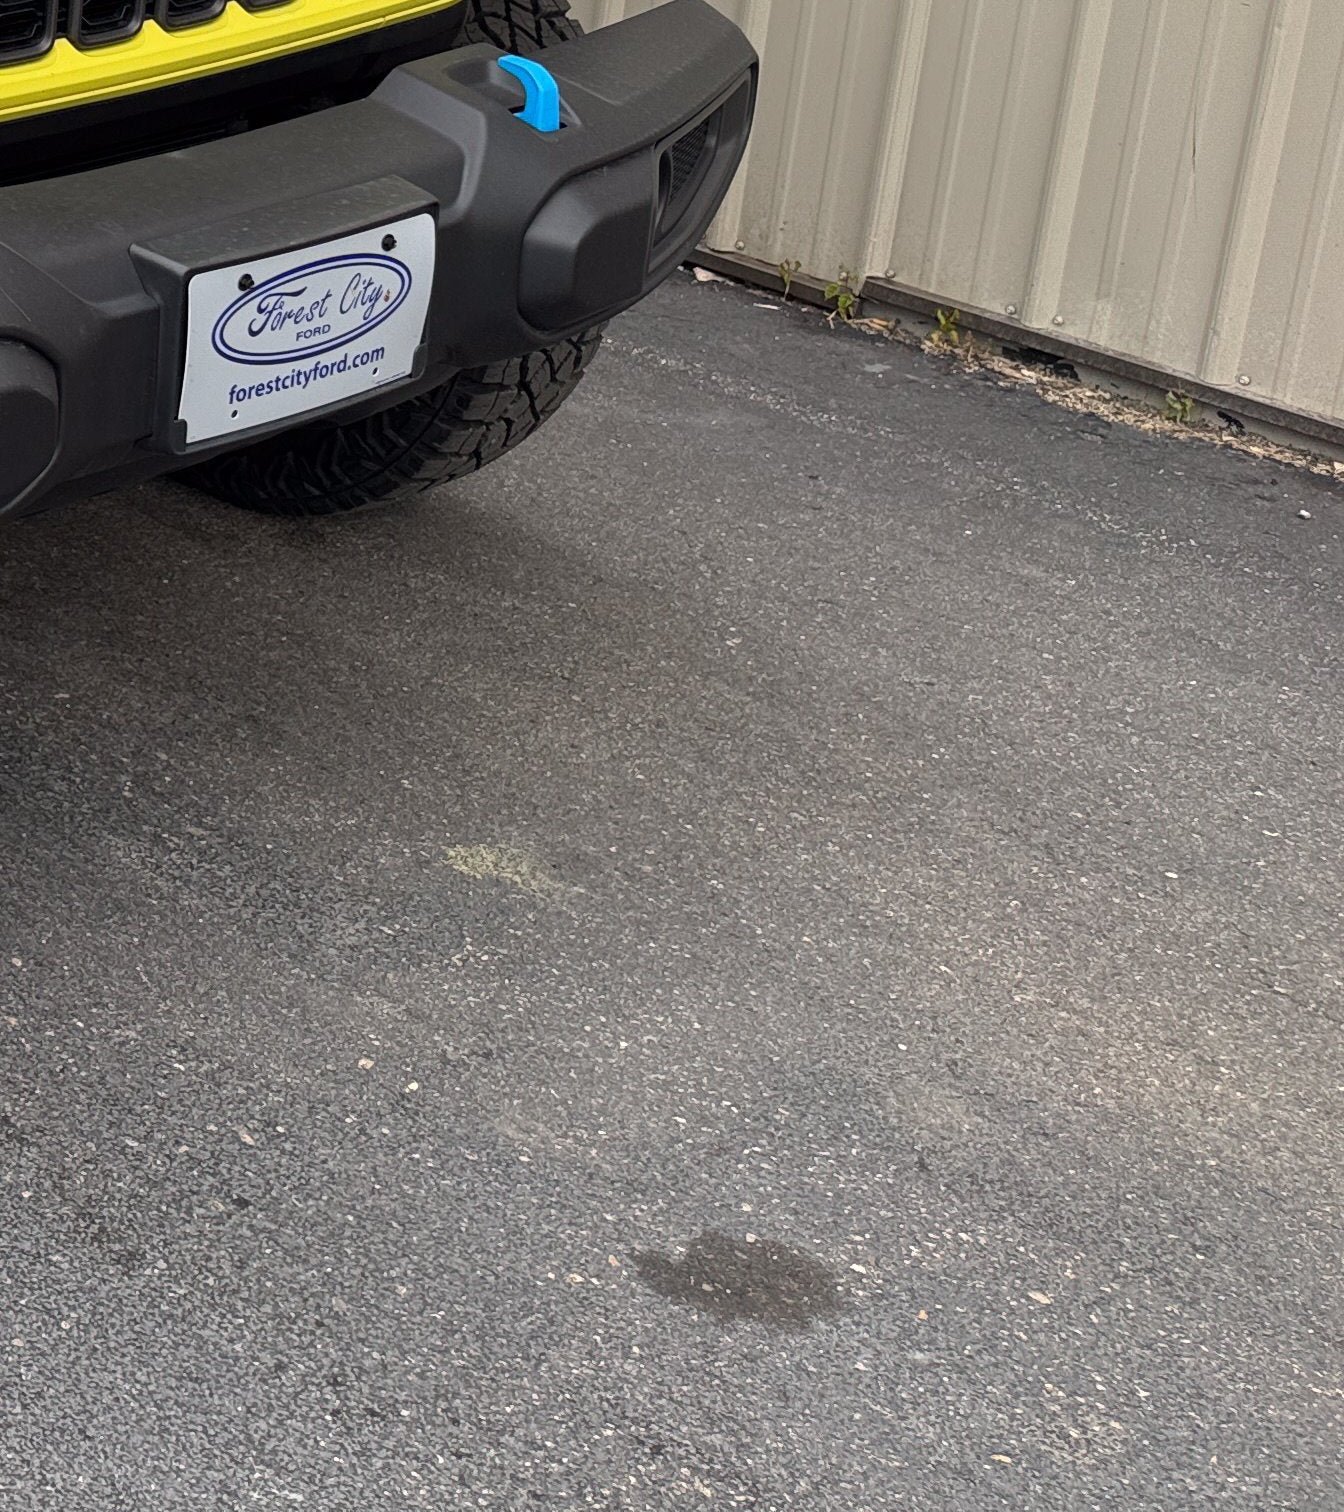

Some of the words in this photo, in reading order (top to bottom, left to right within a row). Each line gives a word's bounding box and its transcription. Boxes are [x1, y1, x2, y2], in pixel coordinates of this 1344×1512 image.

[248, 286, 333, 338] Forest
[339, 272, 383, 321] City
[296, 324, 332, 341] FORD
[228, 345, 385, 404] forestcityford.com
